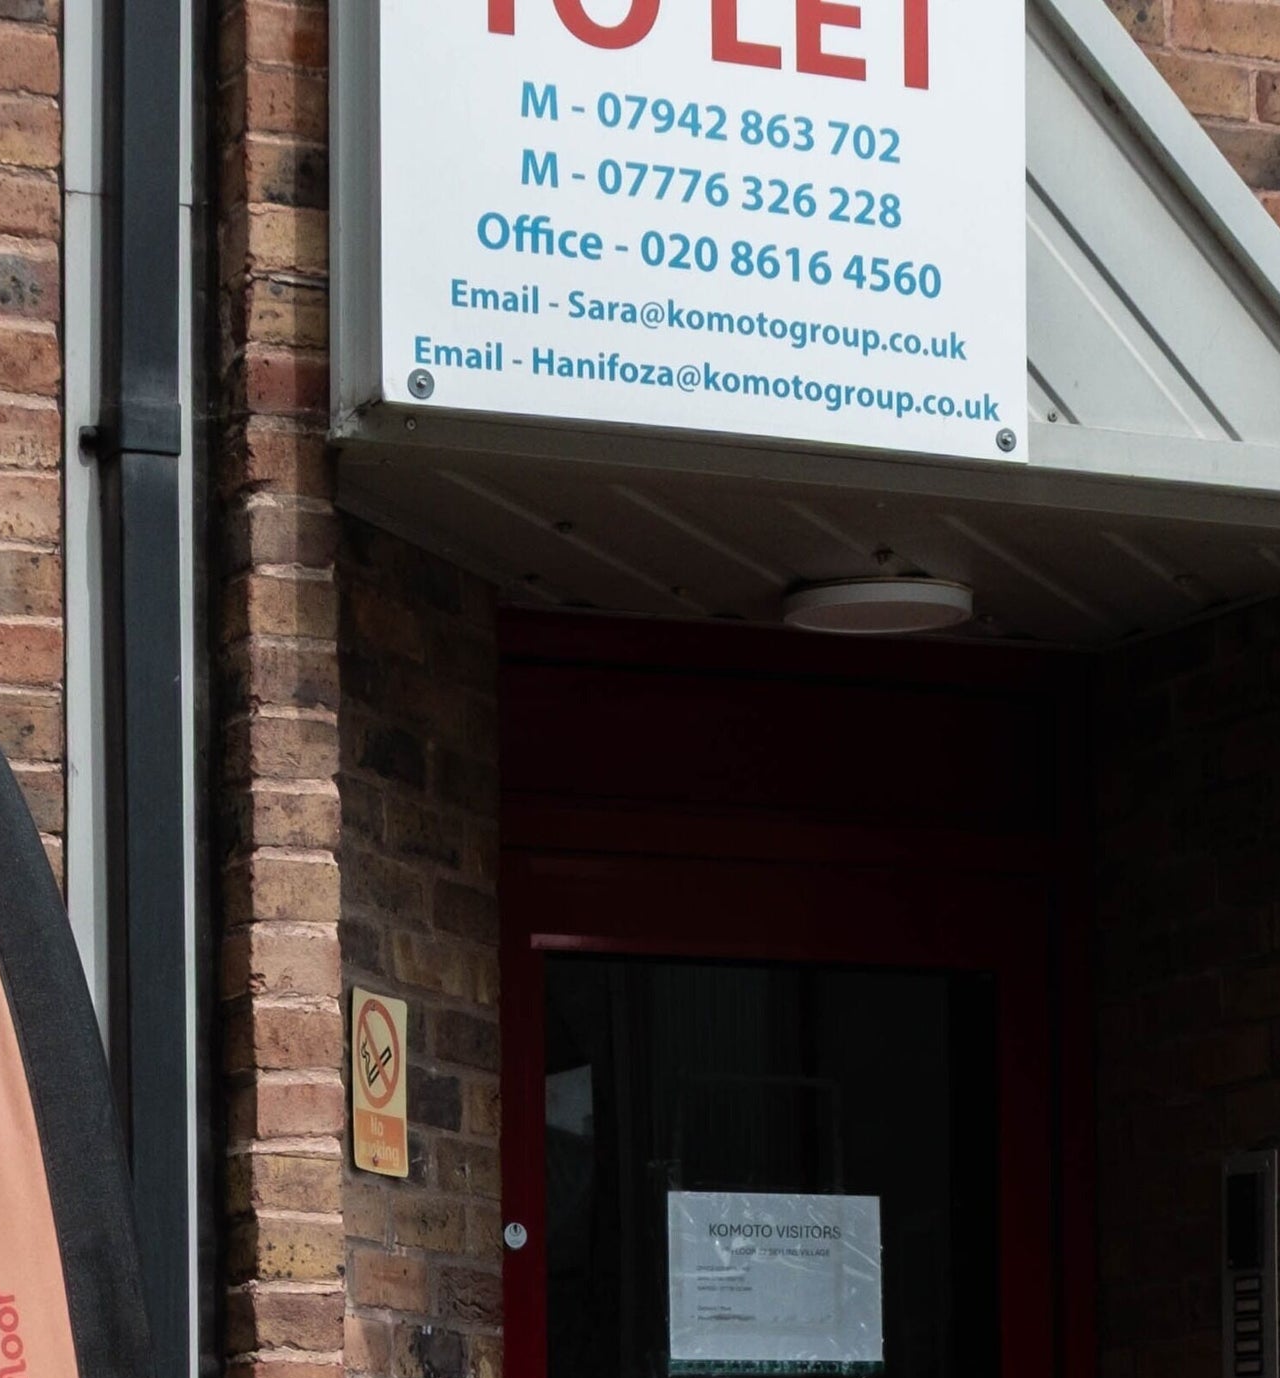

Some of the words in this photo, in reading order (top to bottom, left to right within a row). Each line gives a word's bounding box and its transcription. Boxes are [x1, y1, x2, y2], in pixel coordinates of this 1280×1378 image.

[520, 81, 559, 122] M
[597, 92, 728, 142] 07942
[740, 109, 815, 153] 863
[828, 121, 902, 164] 702
[521, 149, 559, 189] M
[597, 159, 729, 208] 07776
[741, 176, 817, 218] 326
[828, 186, 902, 229] 228
[477, 211, 602, 260] Office
[641, 230, 718, 272] 020
[730, 243, 832, 285] 8616
[843, 255, 941, 299] 4560
[451, 279, 540, 315] Email
[568, 290, 966, 361] Sara@komotogroup.co.uk
[414, 336, 503, 373] Email
[532, 348, 1000, 423] Hanifoza@komotogroup.co.uk
[709, 1224, 772, 1238] KOMOTO
[776, 1225, 841, 1239] VISITORS
